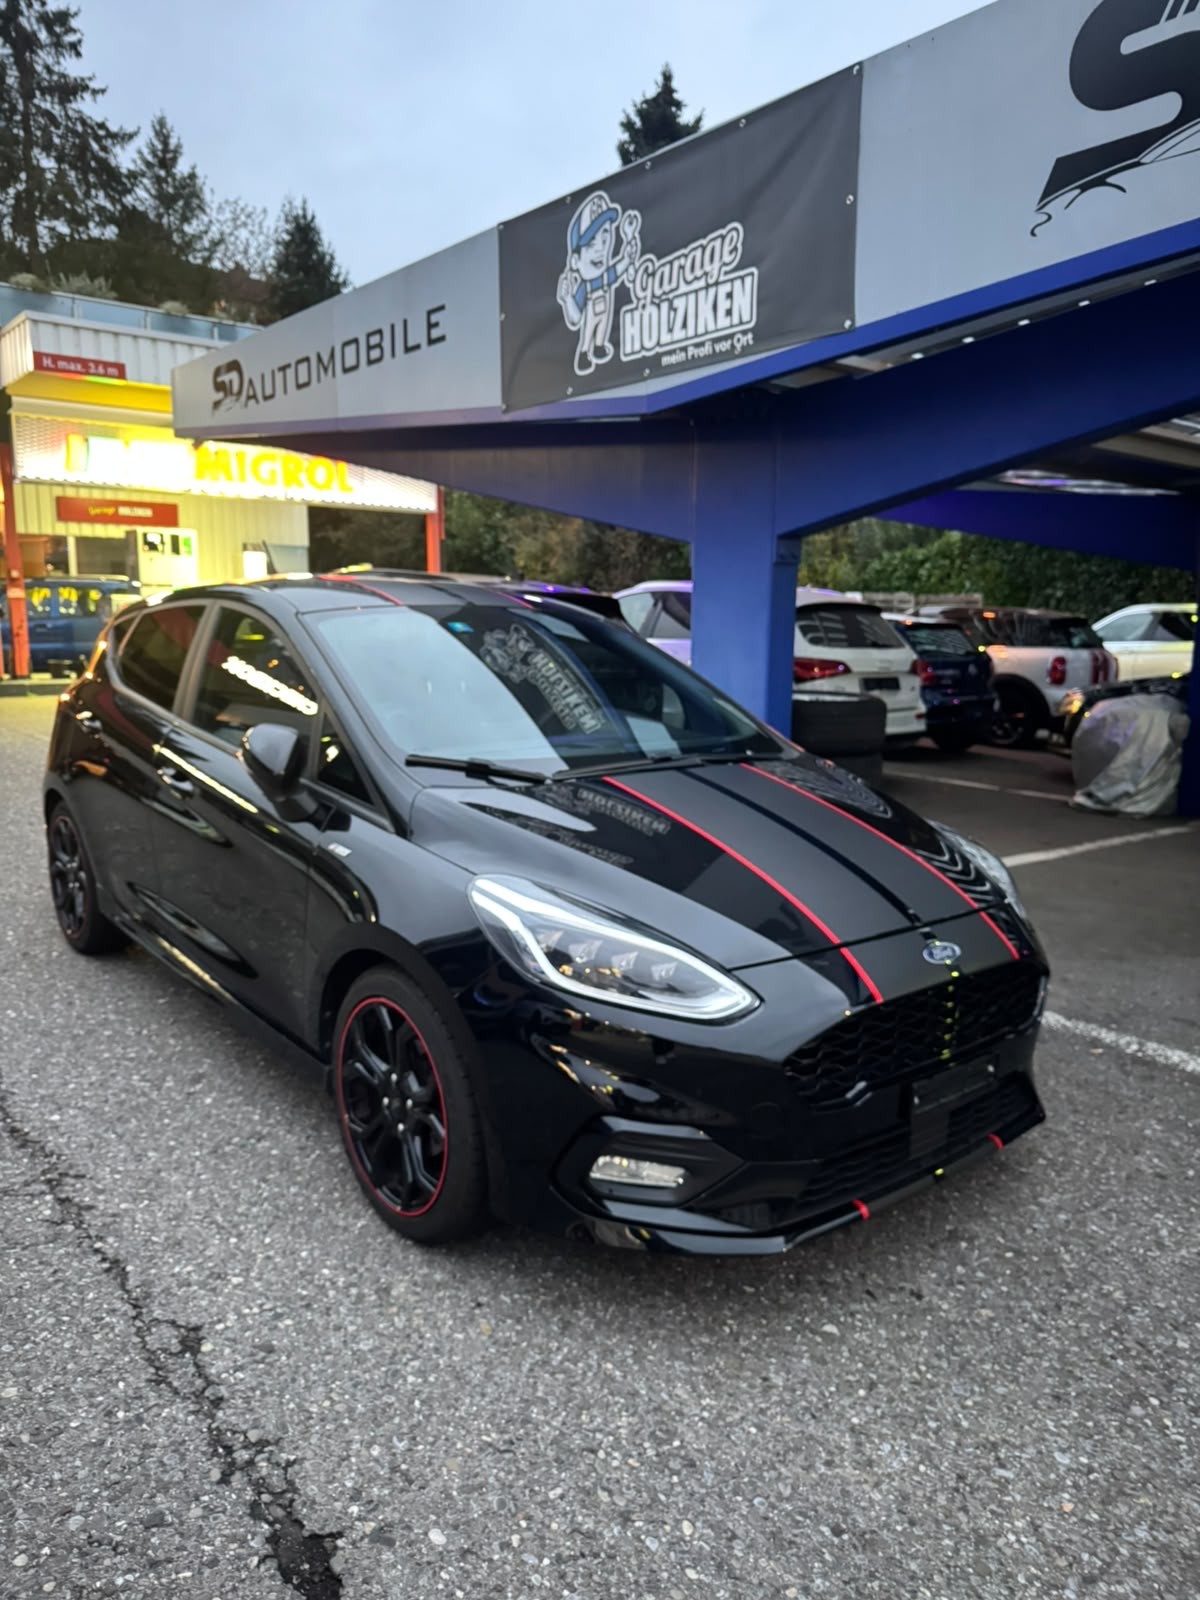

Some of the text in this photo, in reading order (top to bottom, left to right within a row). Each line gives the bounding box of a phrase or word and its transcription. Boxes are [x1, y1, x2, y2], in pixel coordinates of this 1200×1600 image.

[635, 229, 738, 308] Garage
[624, 275, 753, 355] HOLZIKEN
[661, 332, 754, 366] mein Profi vor Ort
[244, 304, 447, 408] AUTOMOBILE
[194, 446, 353, 492] MIGROL
